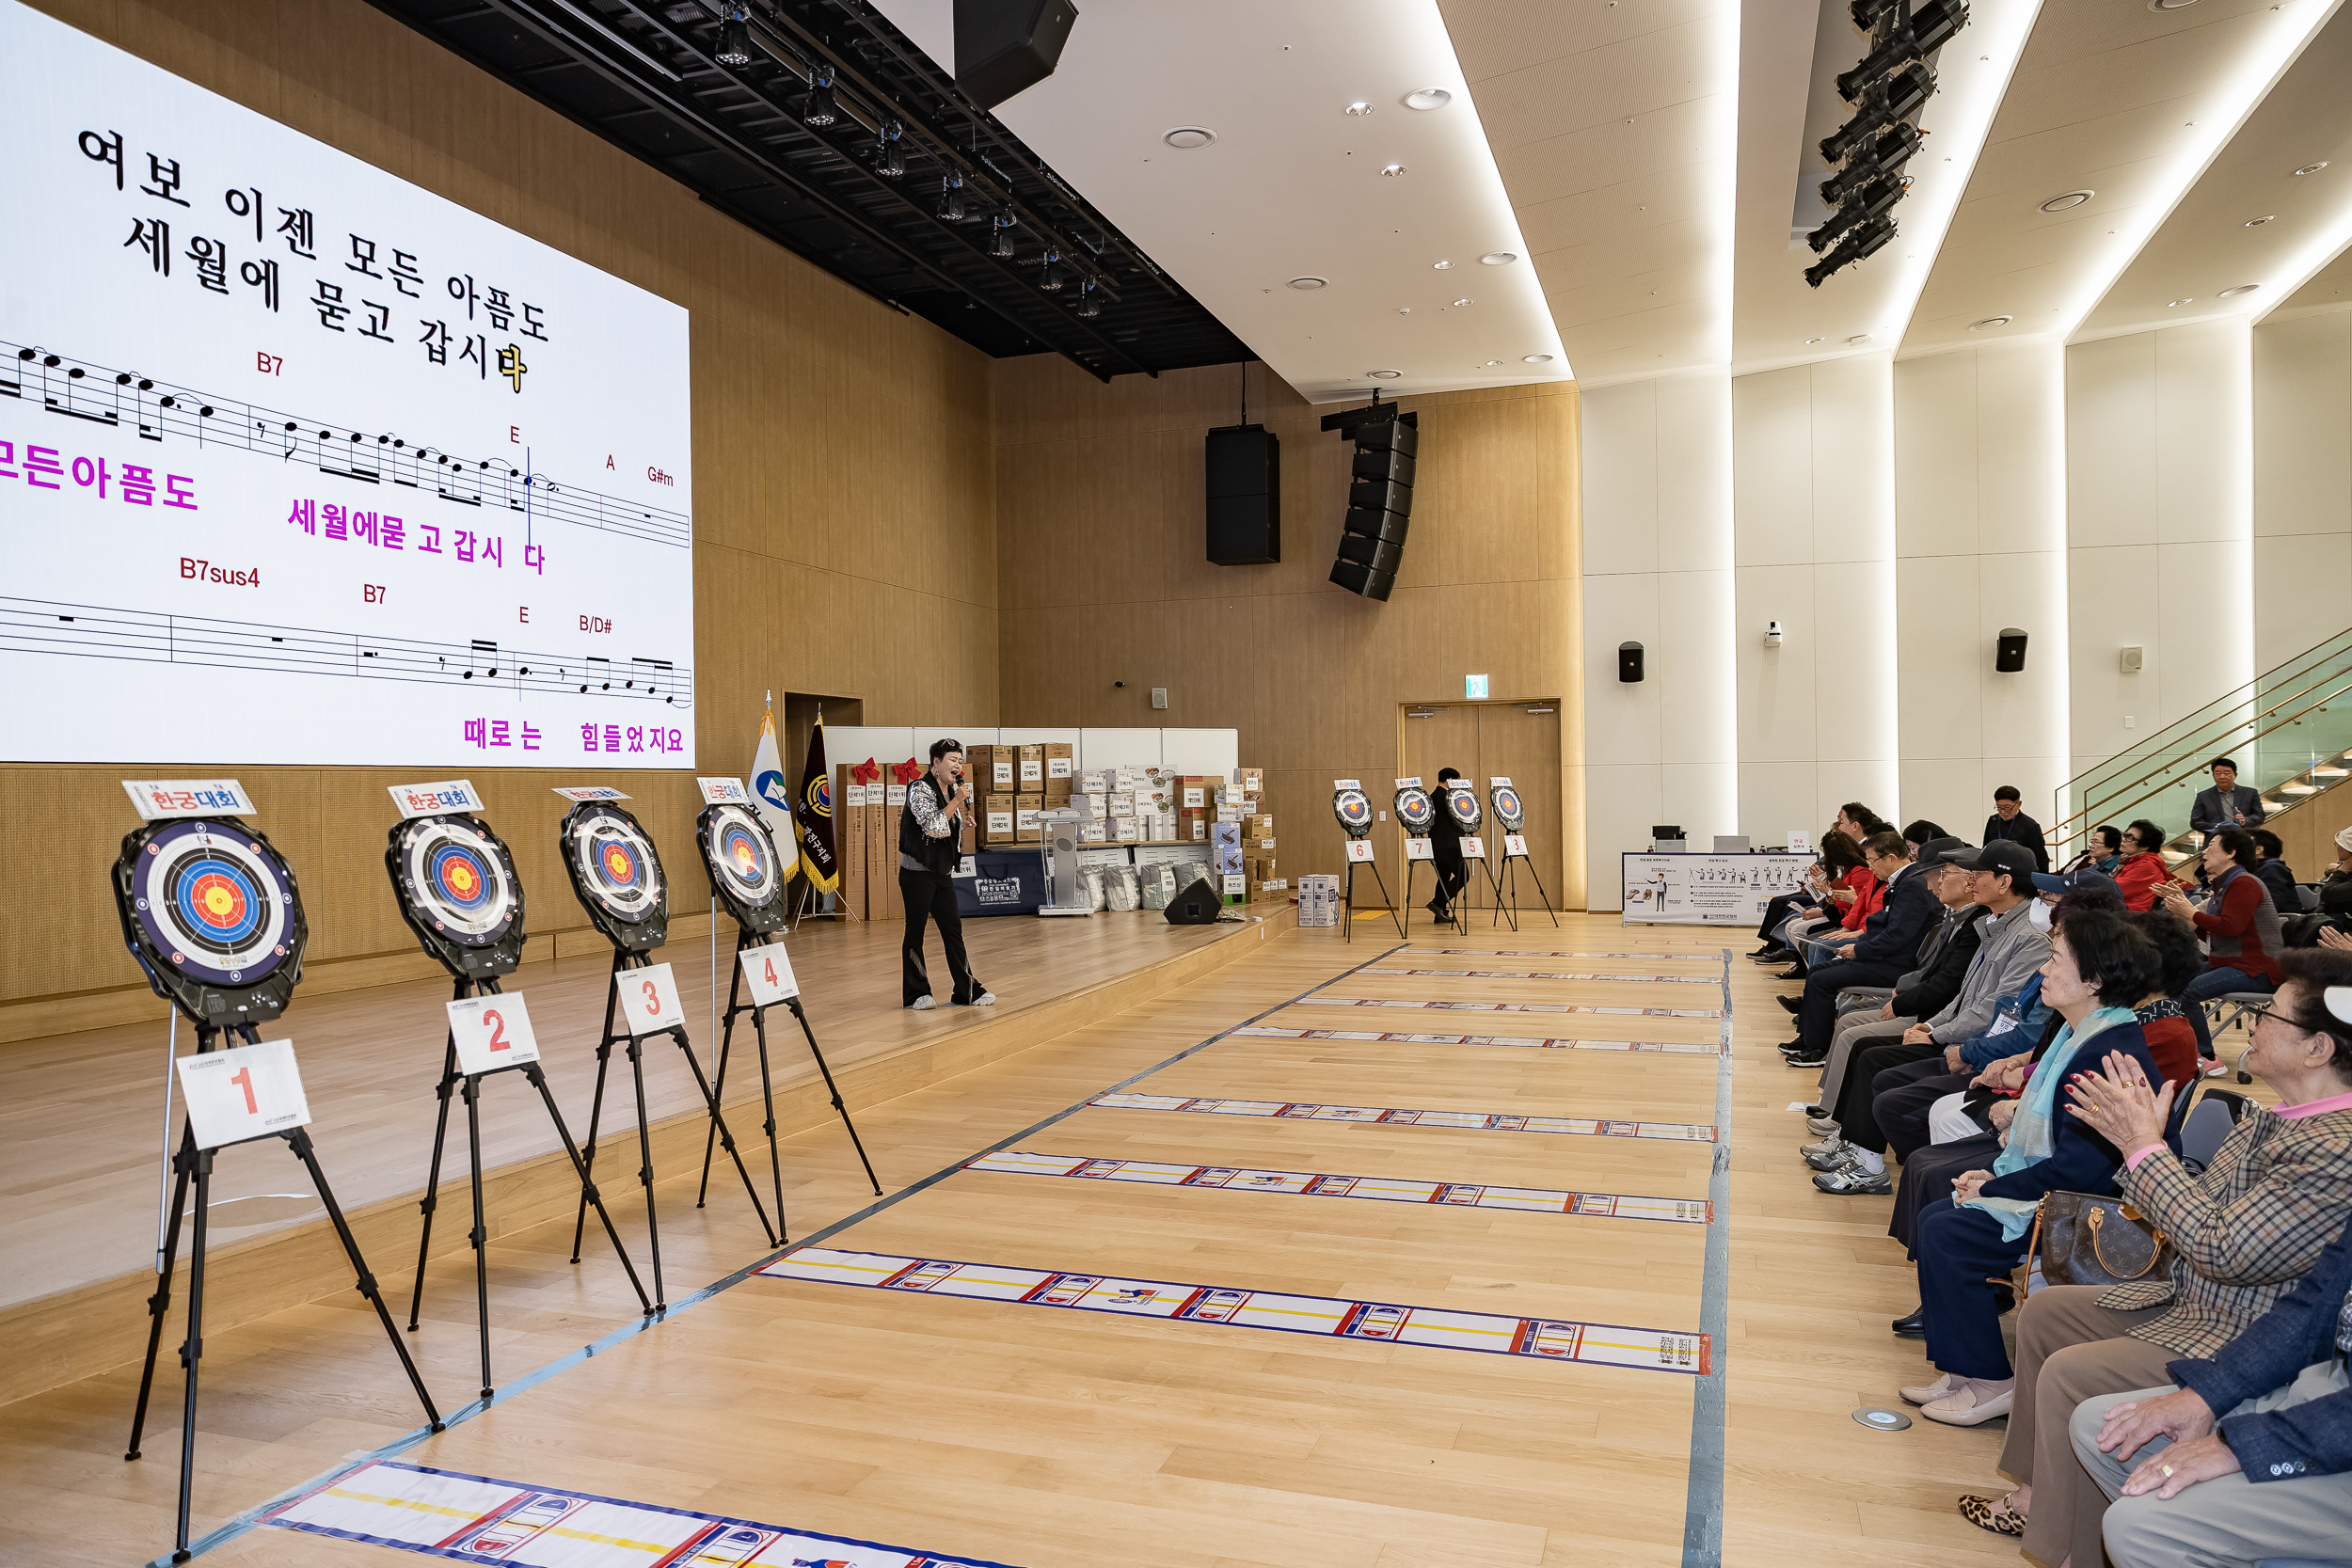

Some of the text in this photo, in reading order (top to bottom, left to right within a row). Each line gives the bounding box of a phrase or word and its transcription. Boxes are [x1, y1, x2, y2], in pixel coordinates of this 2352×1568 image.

[79, 131, 548, 345] 여보 이젠 모든 아픔도
[124, 213, 528, 394] 세월에 묻고 갑시다
[258, 352, 674, 484] B7 E A G#m
[181, 558, 611, 632] B7sus4 B7 E B/D#
[152, 791, 239, 809] 한궁대회
[406, 789, 470, 811] 한궁대회
[569, 789, 622, 800] 한궁대회
[707, 785, 742, 799] 한궁대회
[1357, 845, 1363, 856] 6
[1416, 843, 1422, 853] 7
[1470, 841, 1475, 852] 5
[765, 958, 778, 987] 4
[643, 981, 660, 1015] 3
[484, 1009, 511, 1052] 2
[231, 1067, 258, 1114] 1
